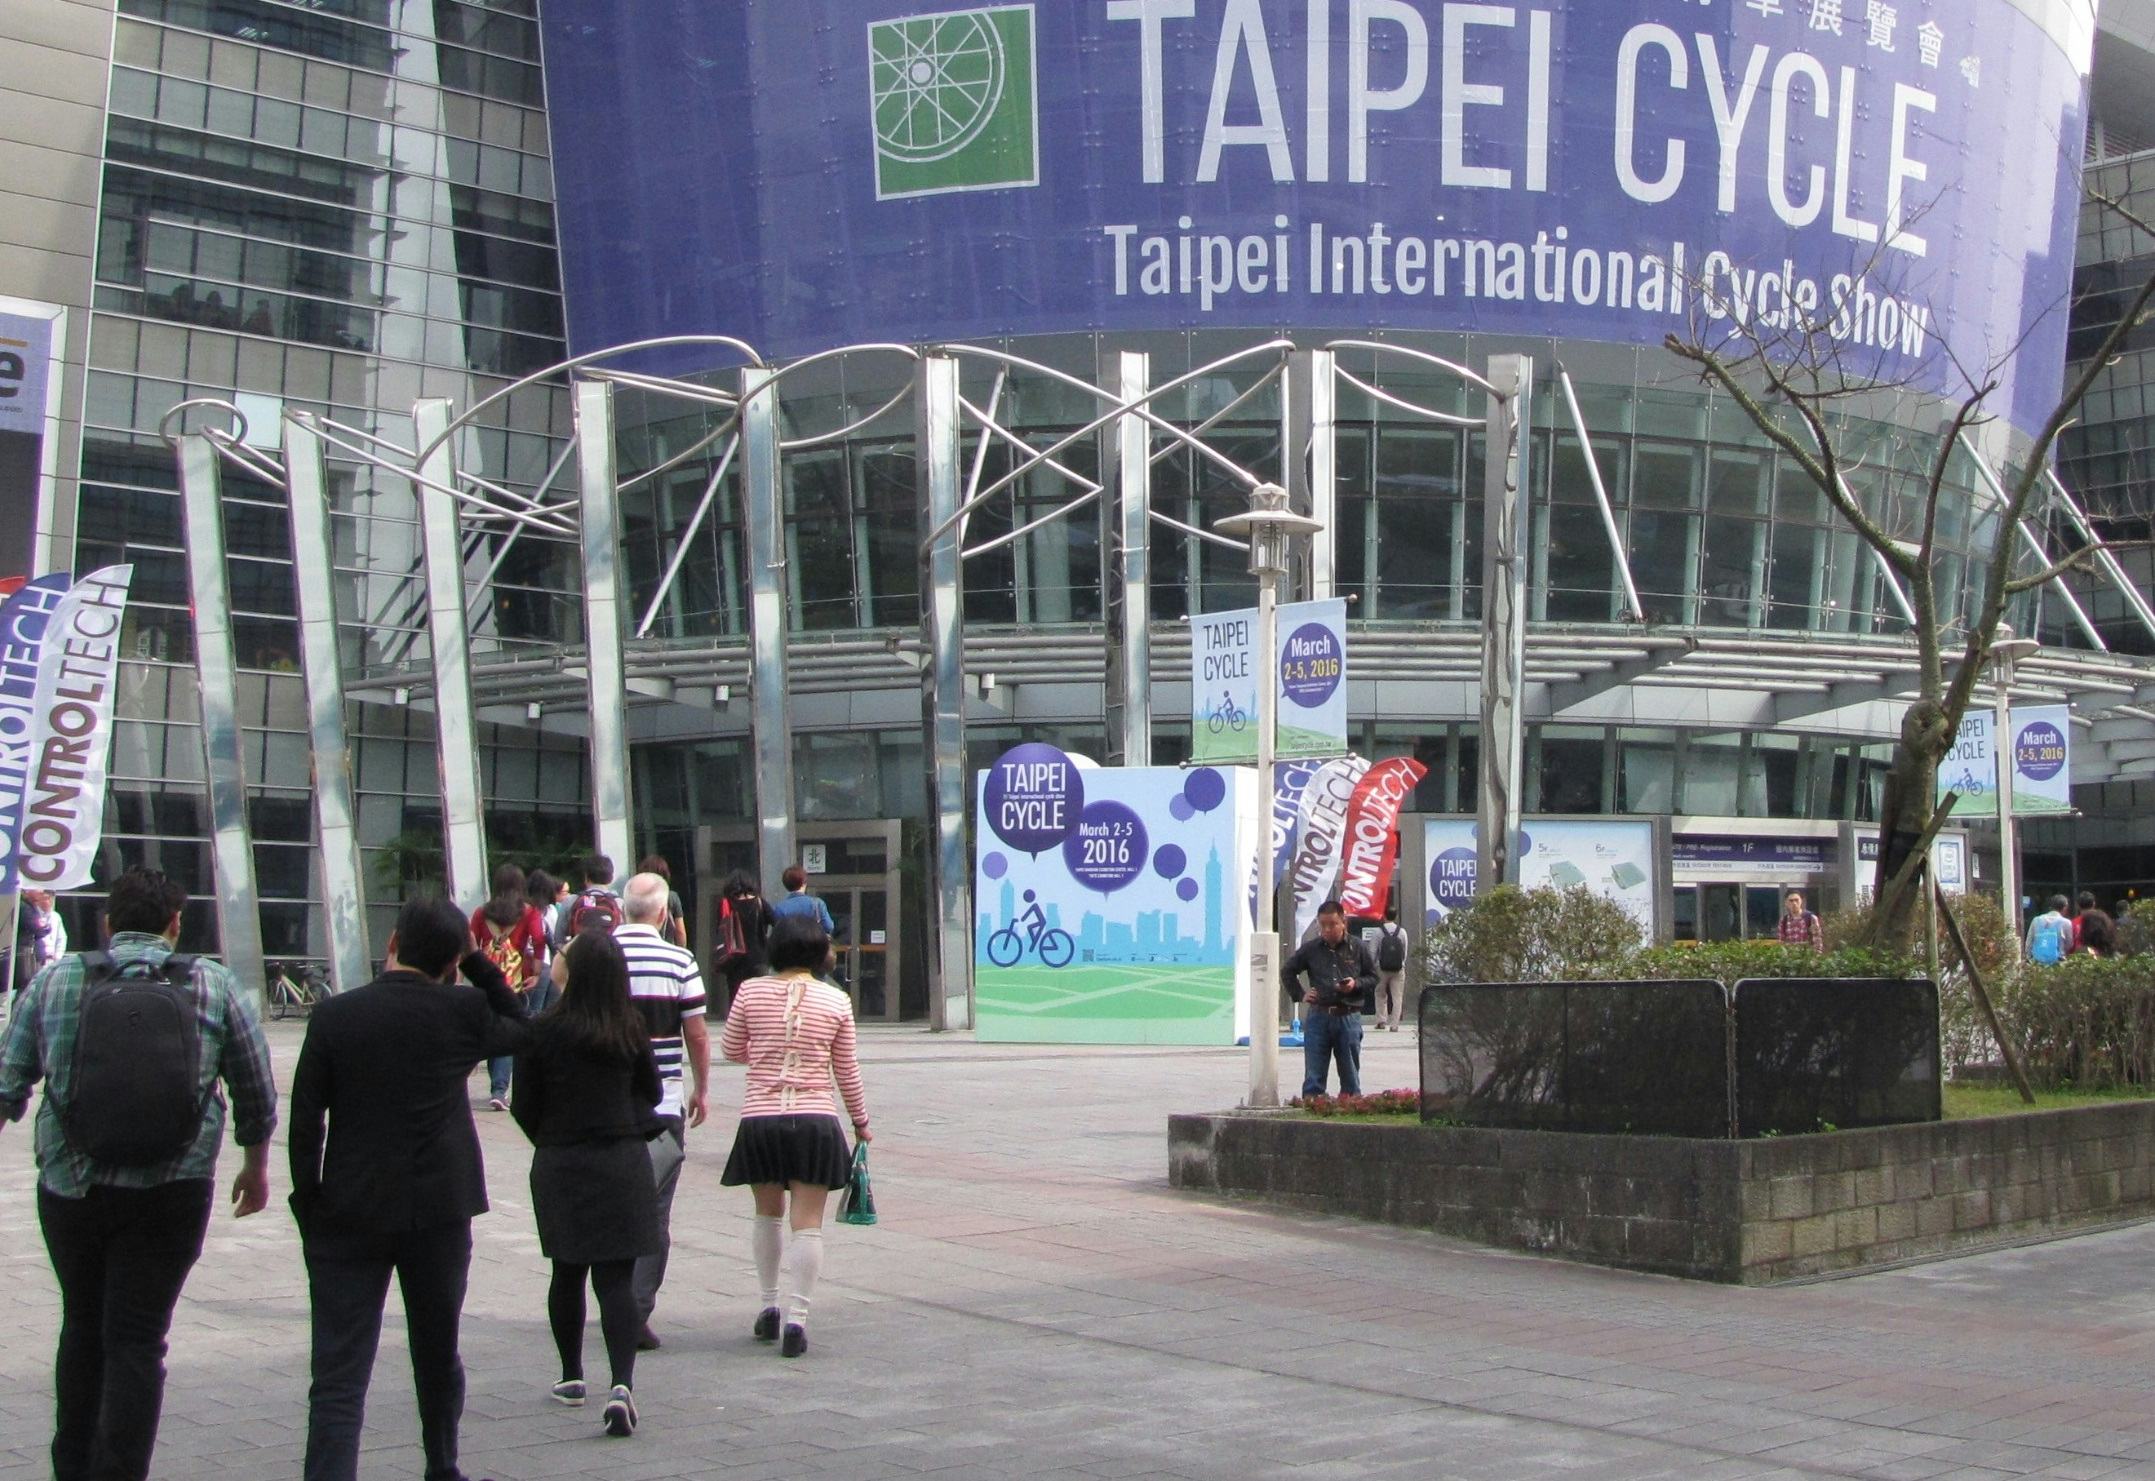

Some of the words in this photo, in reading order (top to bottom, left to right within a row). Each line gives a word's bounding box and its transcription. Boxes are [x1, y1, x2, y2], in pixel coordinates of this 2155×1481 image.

[1107, 0, 1551, 191] TAIPEI
[1614, 23, 1936, 257] CYCLE
[1104, 214, 1288, 311] Taipei
[1310, 222, 1684, 314] International
[1703, 251, 1817, 339] Cycle
[1828, 273, 1928, 357] Show
[1203, 620, 1249, 650] TAIPEI
[1291, 634, 1330, 658] March
[1204, 652, 1249, 681] CYCLE
[1284, 661, 1308, 680] 2-5,
[1311, 658, 1338, 677] 2016
[19, 579, 130, 882] CONTROLTECH
[1956, 718, 1984, 738] AIPEI
[2023, 731, 2056, 745] March
[2018, 749, 2038, 762] 2-5,
[2040, 747, 2064, 760] 2016
[1002, 763, 1066, 792] TAIPEI
[1002, 801, 1065, 830] CYCLE
[1079, 822, 1109, 837] March
[1113, 822, 1133, 836] 2-5
[1340, 757, 1418, 910] ONTROLTECH
[1083, 839, 1130, 864] 2016
[1439, 859, 1477, 877] TAIPEI
[1439, 879, 1477, 897] CYCLE
